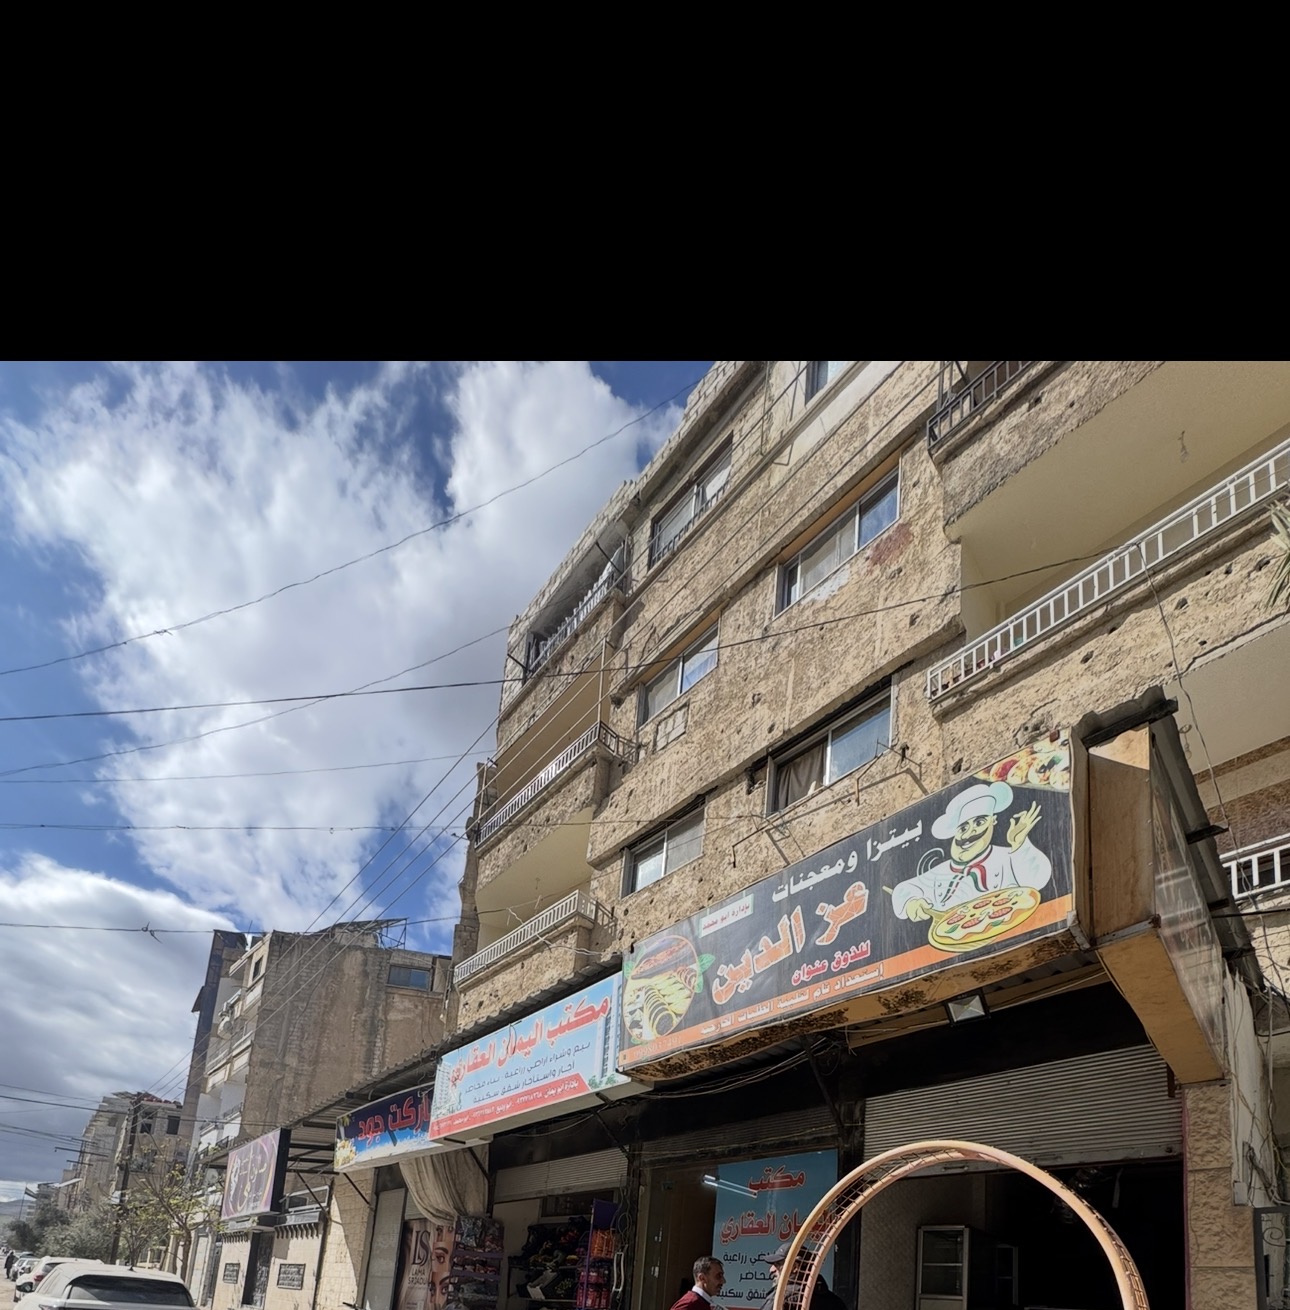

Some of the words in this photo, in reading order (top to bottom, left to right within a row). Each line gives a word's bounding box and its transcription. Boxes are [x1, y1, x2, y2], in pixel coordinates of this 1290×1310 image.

[866, 819, 923, 861] بيتزا
[772, 851, 858, 902] ومعجنات
[815, 881, 869, 945] عز
[712, 905, 806, 1005] الدين
[831, 940, 871, 972] للذوق
[792, 959, 828, 987] عنوان
[813, 985, 830, 999] تام
[546, 996, 610, 1046] مكتب
[737, 1001, 773, 1021] الطلبات
[498, 1018, 544, 1069] اليمان
[549, 1047, 571, 1064] وشراء
[572, 1041, 591, 1057] بيع
[450, 1041, 495, 1088] العقاري
[504, 1066, 526, 1080] زراعية
[473, 1088, 499, 1104] سكنية
[500, 1079, 521, 1096] شقق
[388, 1093, 431, 1135] اركت
[358, 1115, 385, 1147] جود
[748, 1165, 806, 1196] مكتب
[721, 1210, 776, 1245] العقاري
[723, 1252, 747, 1265] زراعية
[717, 1288, 743, 1300] سكني
